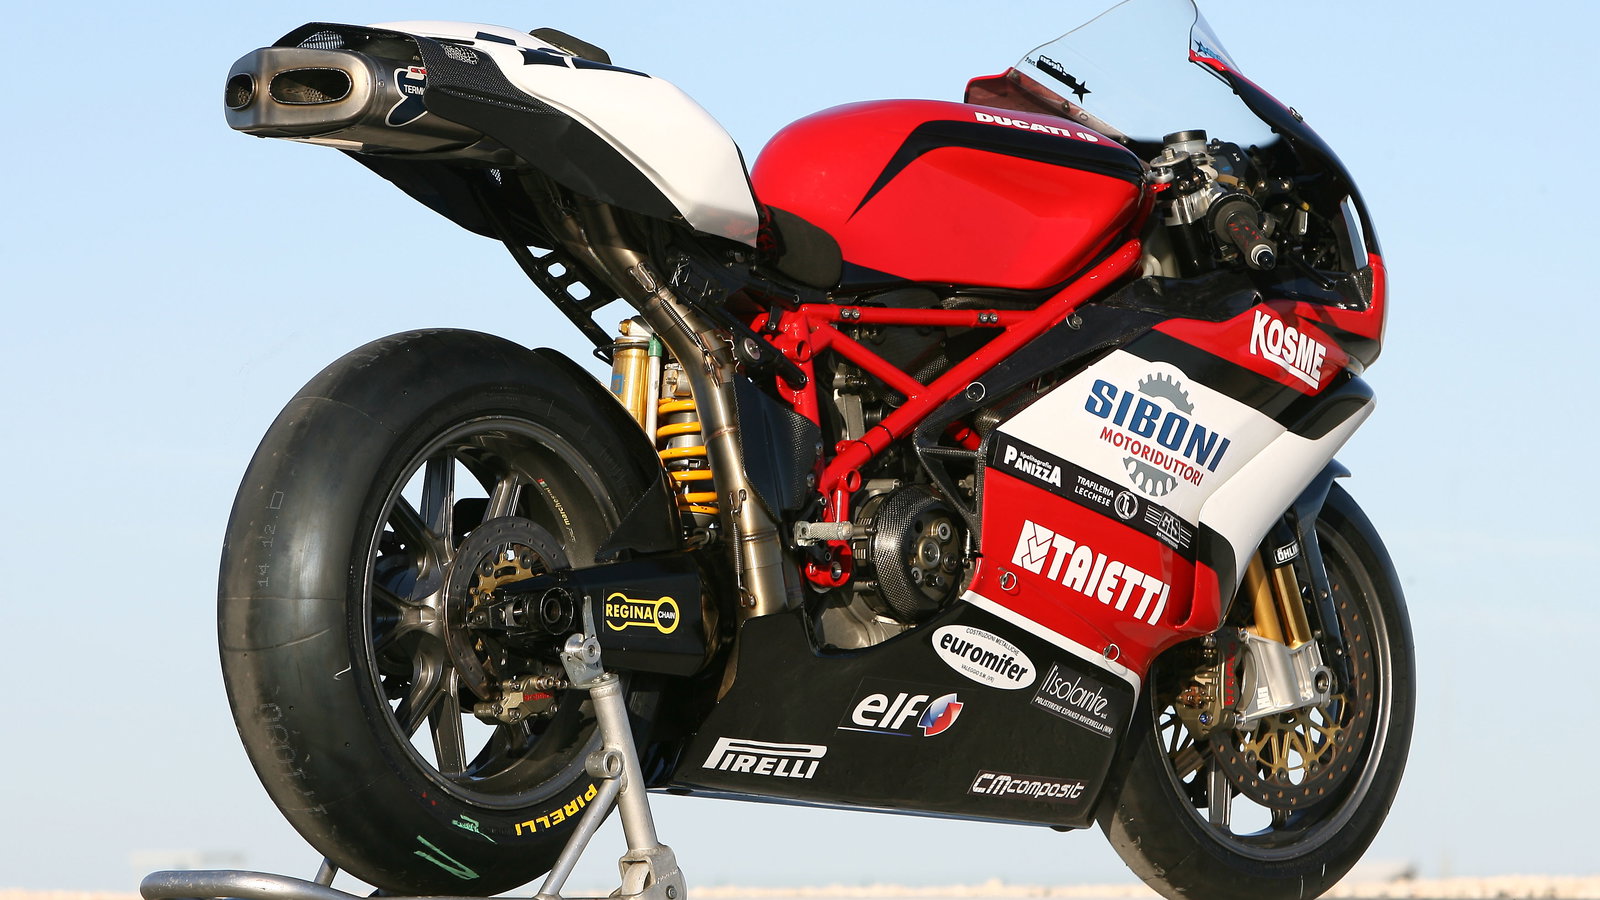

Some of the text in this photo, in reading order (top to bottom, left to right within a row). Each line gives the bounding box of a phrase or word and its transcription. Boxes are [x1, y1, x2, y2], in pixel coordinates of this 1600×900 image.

[974, 112, 1071, 137] DUCATI
[1250, 309, 1327, 390] KOSME
[1085, 379, 1231, 473] SIBONI
[1003, 444, 1062, 487] PANIZZA
[1100, 426, 1204, 487] MOTORIDUTTORI
[1074, 485, 1112, 507] LECCHESE
[1077, 475, 1115, 498] TRAFILERIA
[1046, 533, 1171, 626] TAIETTI
[605, 603, 676, 620] REGINA CHAIN
[940, 633, 1028, 682] euromifer
[965, 627, 1020, 656] COSTRUZIONI METALLICHE
[852, 692, 930, 730] elf
[702, 737, 828, 779] PIRELLI
[514, 783, 598, 836] PIRELLI
